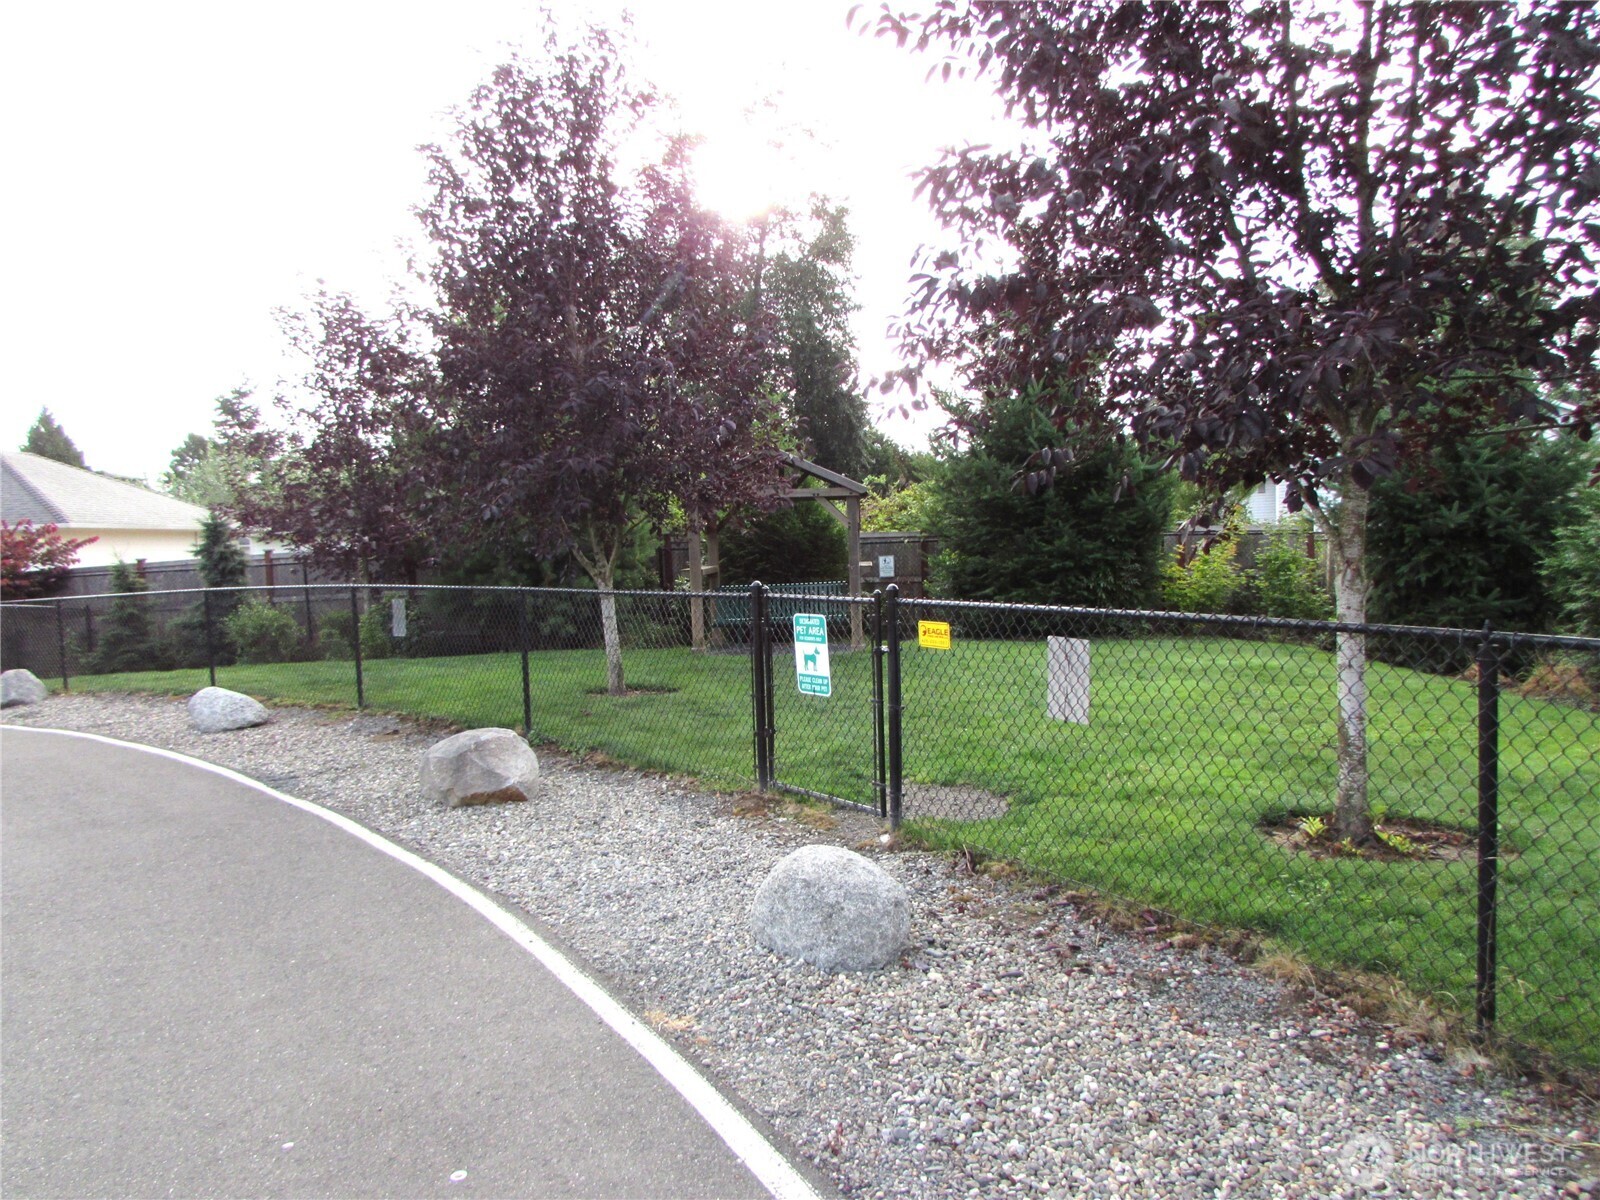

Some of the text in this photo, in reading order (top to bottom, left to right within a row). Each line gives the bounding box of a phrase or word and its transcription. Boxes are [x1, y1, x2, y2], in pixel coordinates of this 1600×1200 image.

[796, 626, 824, 636] PET AREA
[927, 627, 948, 636] EAGLE
